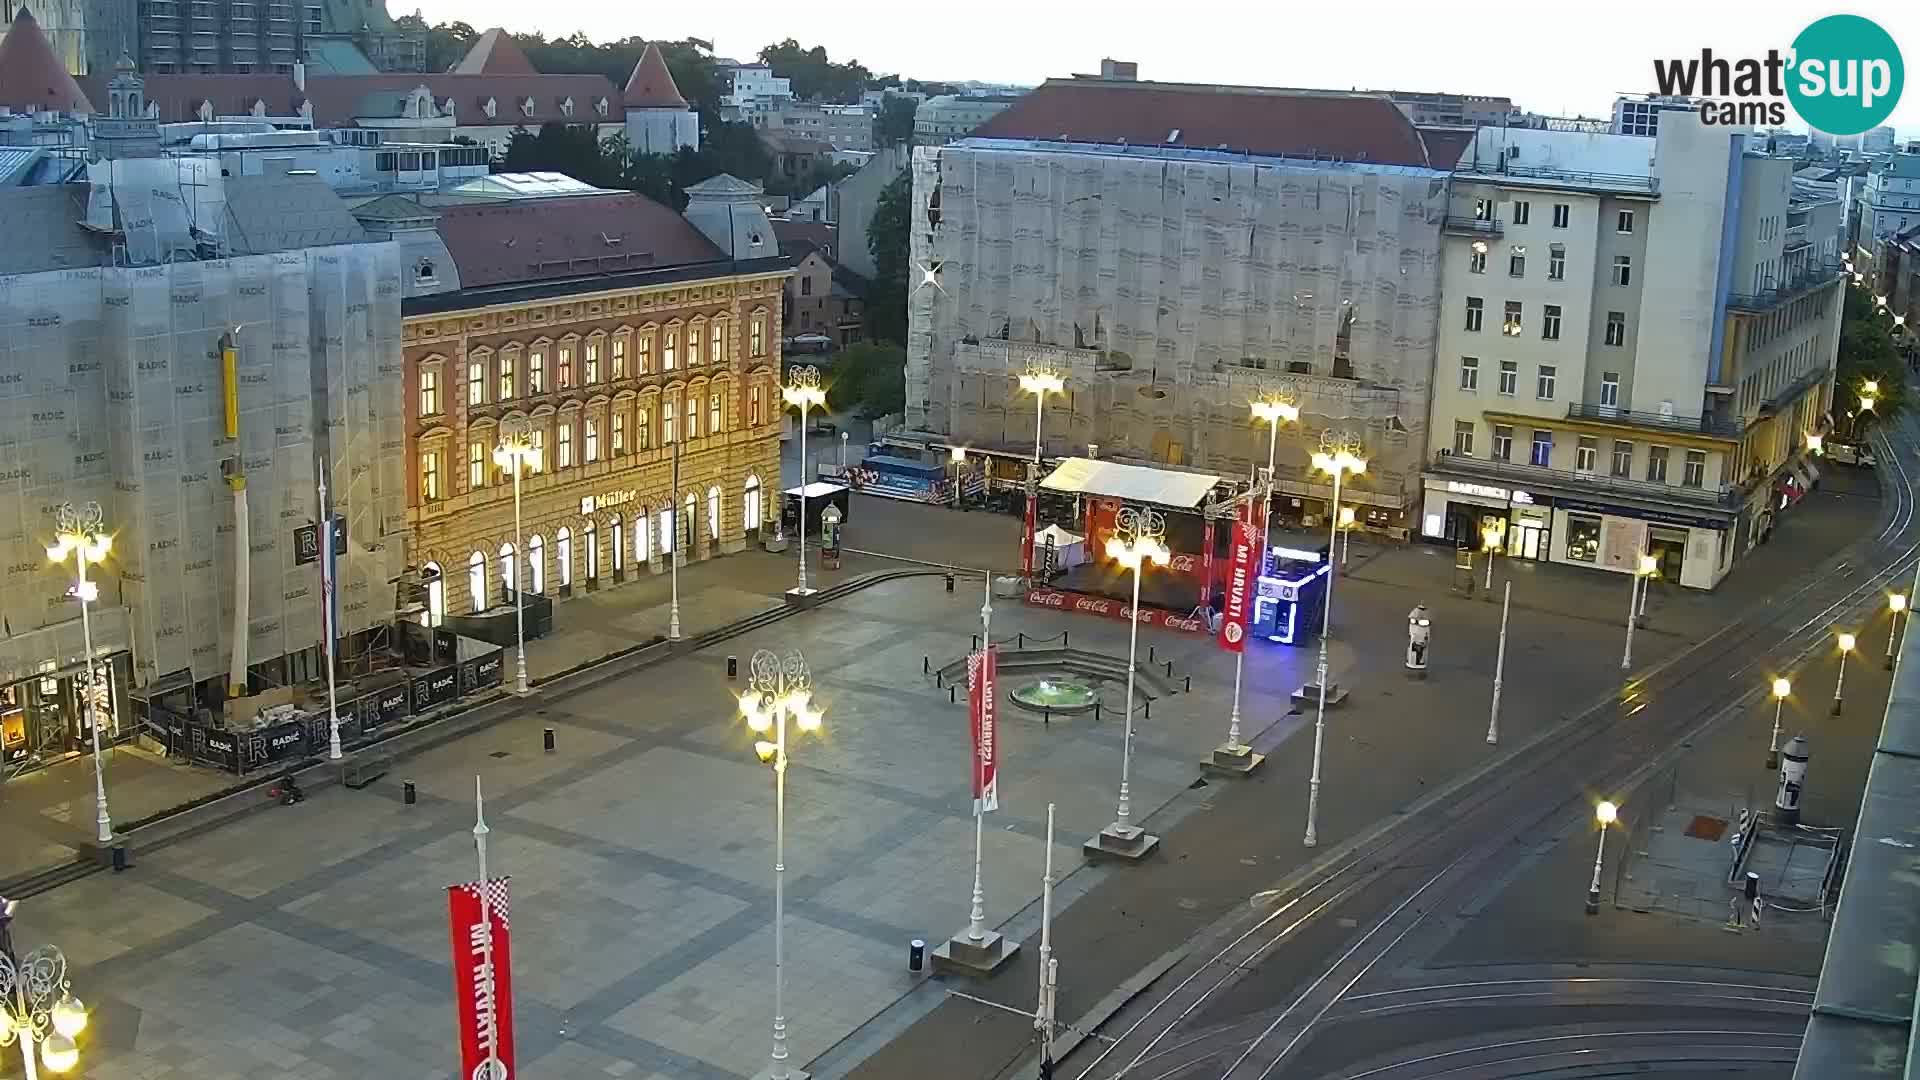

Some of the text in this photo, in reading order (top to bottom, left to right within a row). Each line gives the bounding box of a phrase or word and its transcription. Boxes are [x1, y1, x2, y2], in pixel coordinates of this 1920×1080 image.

[595, 489, 637, 510] Müller
[1229, 544, 1249, 618] MI HRVATI
